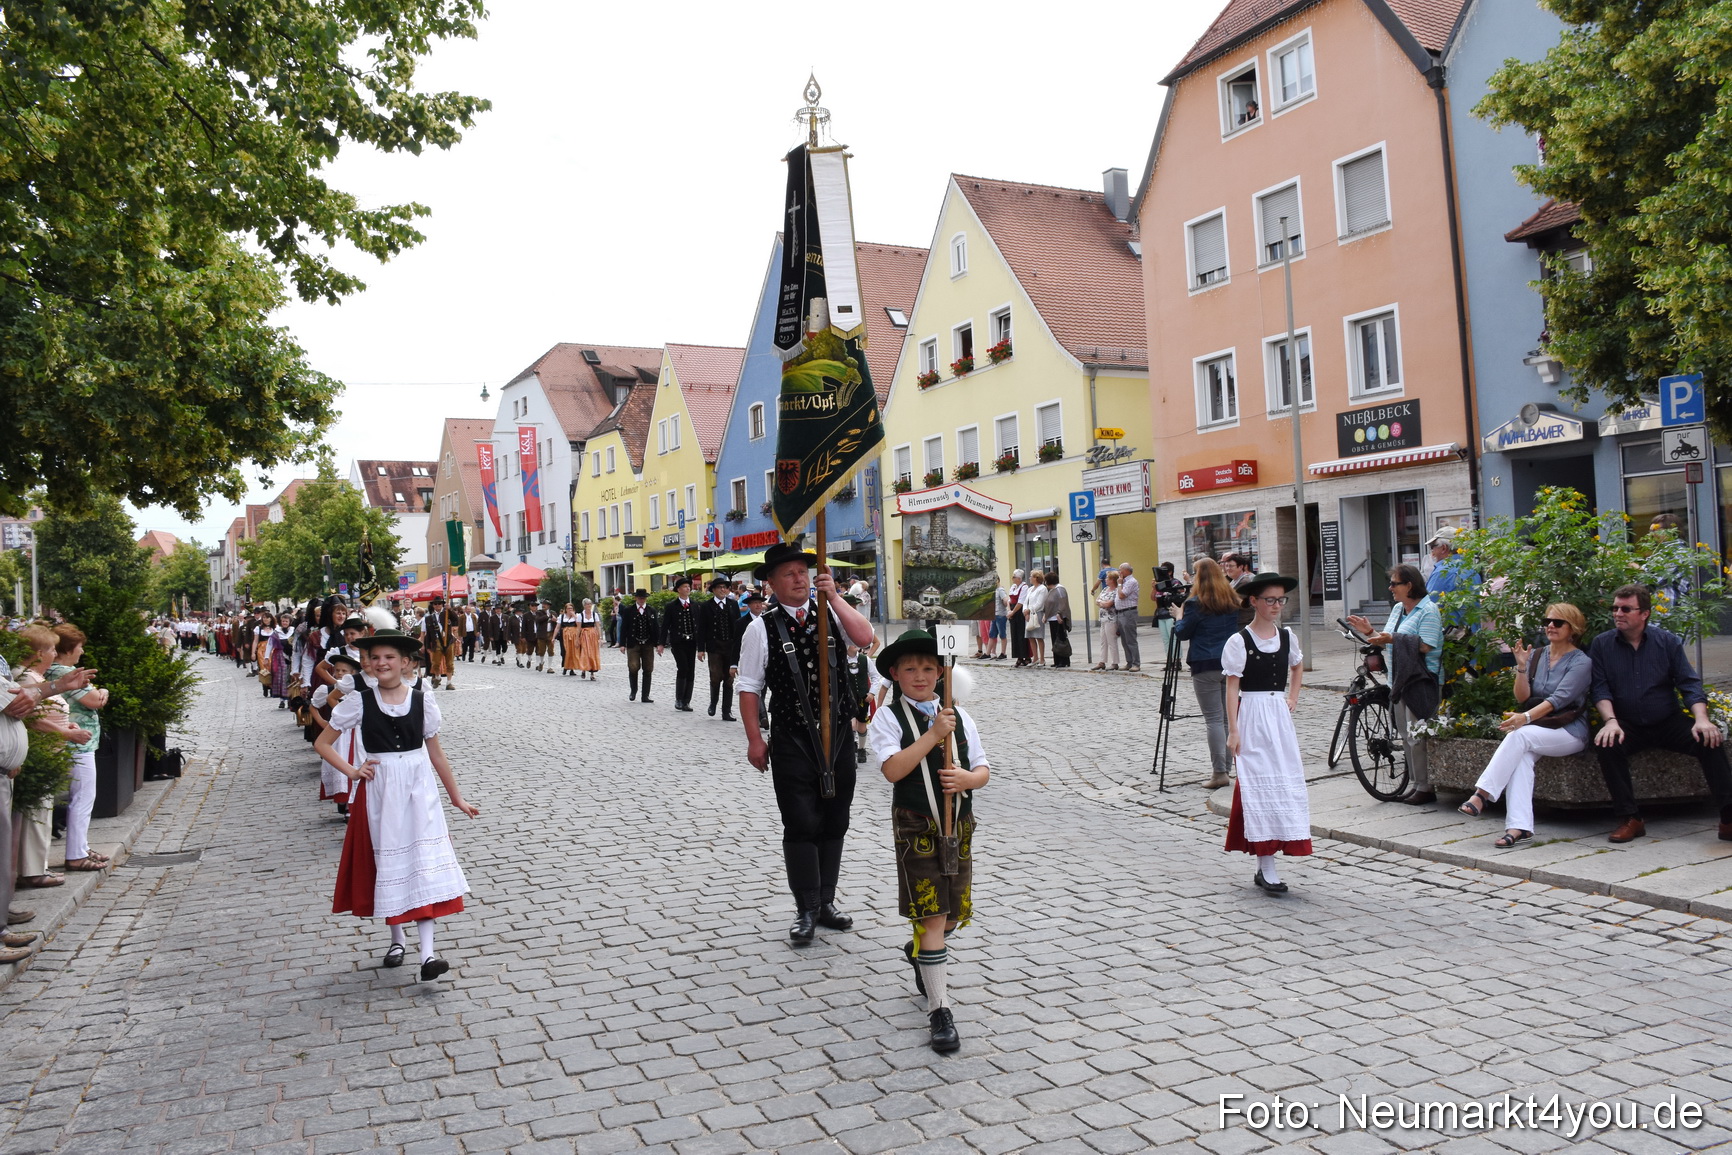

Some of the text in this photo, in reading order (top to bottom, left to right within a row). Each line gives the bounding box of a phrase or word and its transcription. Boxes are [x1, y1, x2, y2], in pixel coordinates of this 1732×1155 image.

[1669, 381, 1693, 420] P
[521, 430, 530, 455] K&L
[1676, 431, 1691, 440] nur
[1351, 445, 1369, 453] OBST
[1377, 439, 1406, 450] GEMÜSE
[1237, 463, 1253, 475] DER
[1142, 462, 1150, 508] KINO
[1179, 475, 1195, 489] DER
[1490, 476, 1500, 486] 16
[601, 487, 617, 502] HOTEL
[1093, 482, 1132, 497] RIALTO KINO
[1074, 495, 1089, 518] P
[731, 530, 780, 550] APOTHEKE
[941, 635, 955, 650] 10
